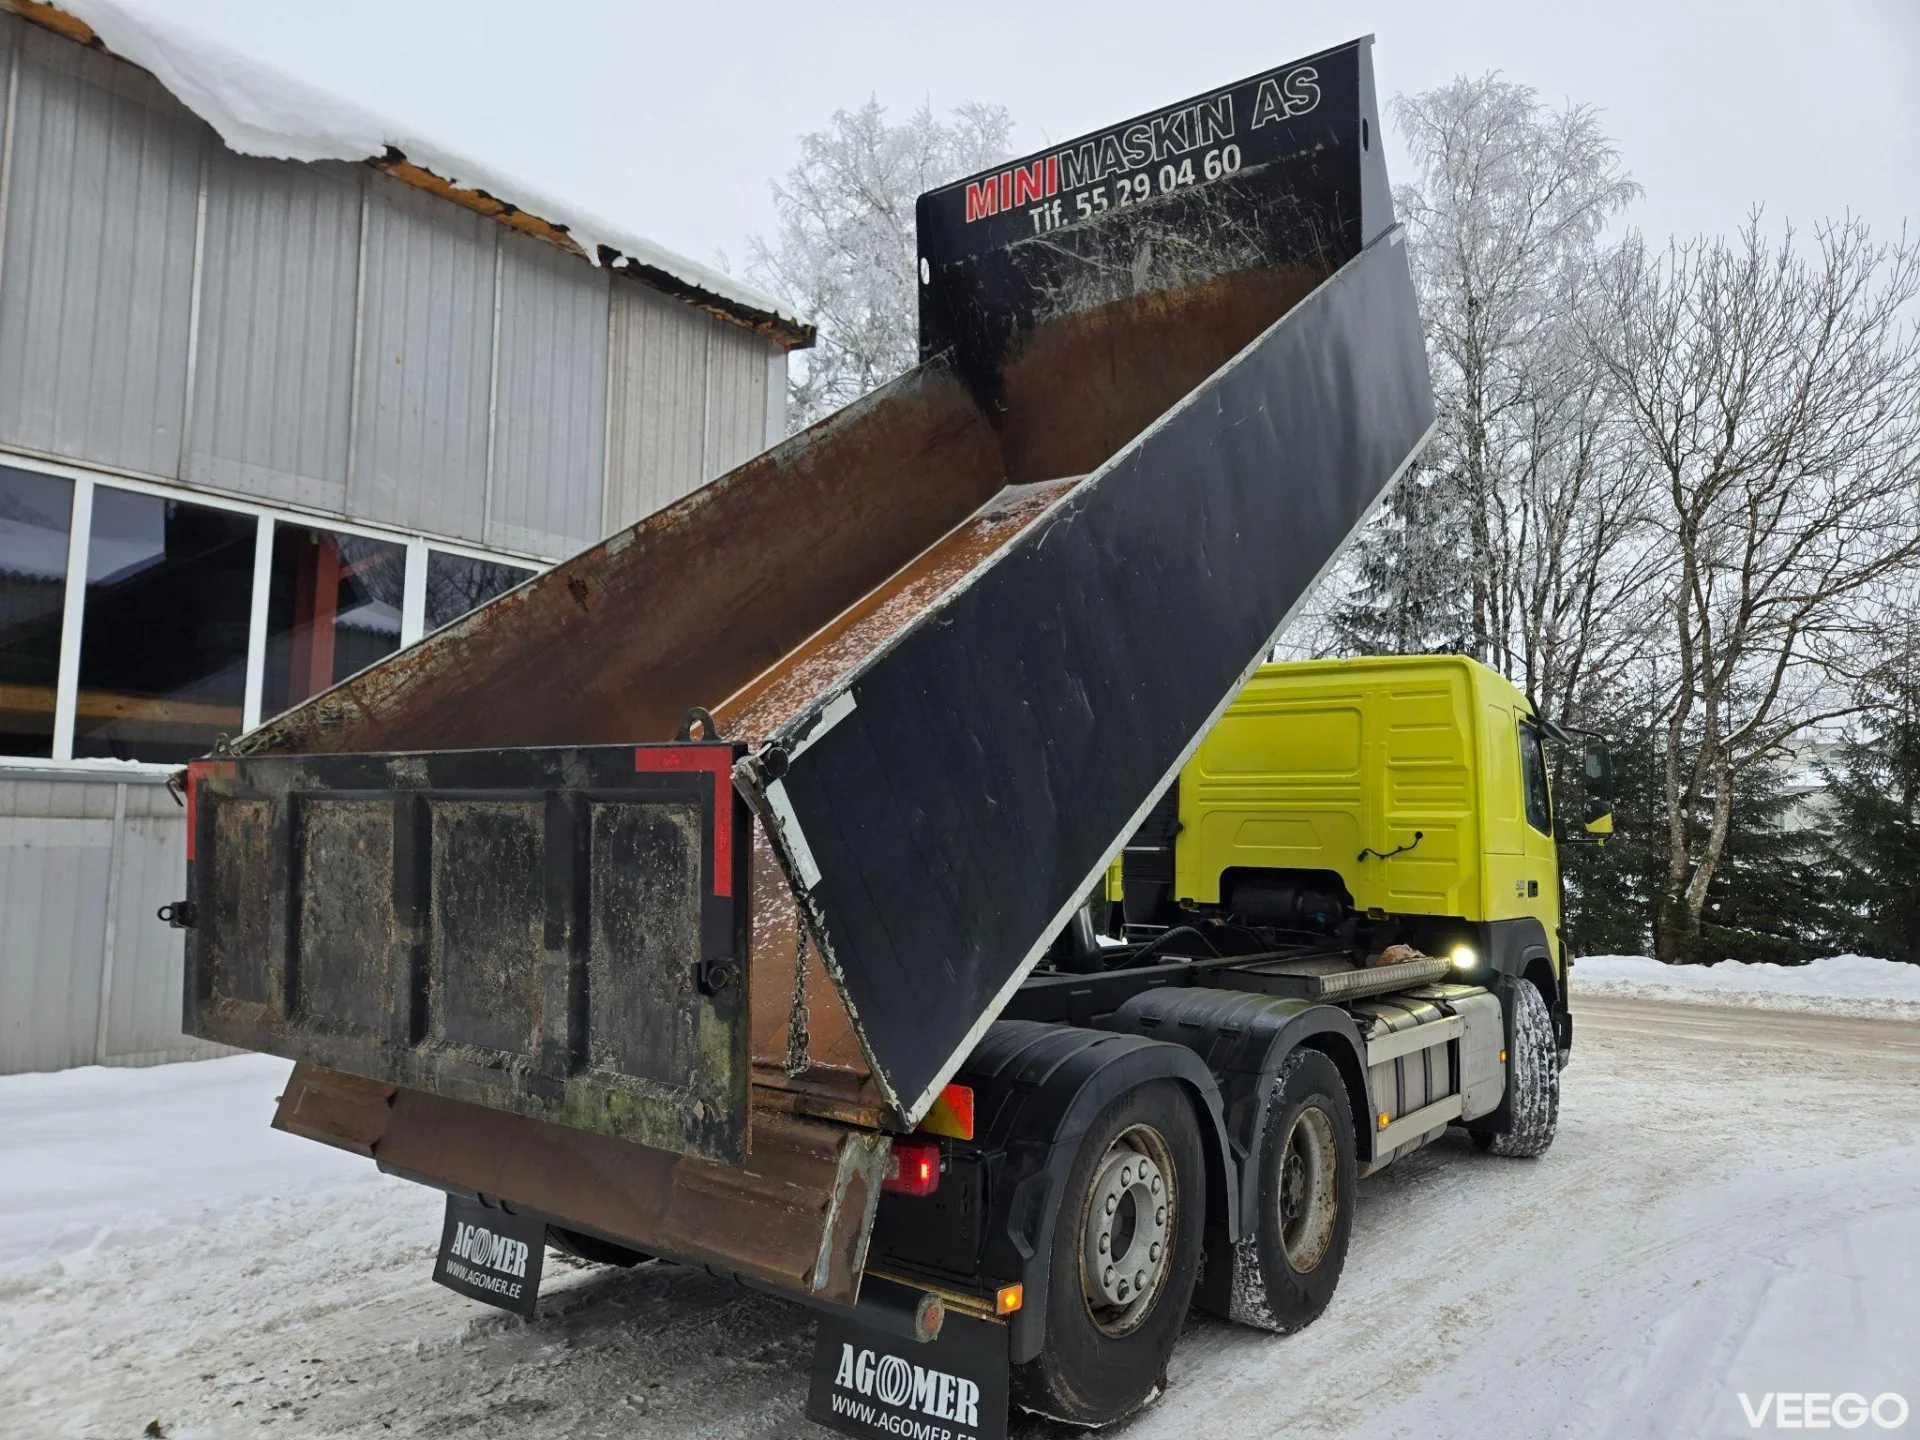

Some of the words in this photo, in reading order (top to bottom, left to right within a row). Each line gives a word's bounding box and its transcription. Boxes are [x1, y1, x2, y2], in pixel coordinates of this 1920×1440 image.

[965, 94, 1236, 223] MINIMASKIN
[1250, 66, 1321, 130] AS
[1076, 186, 1108, 221] 55
[1116, 172, 1151, 208] 29
[1158, 158, 1196, 194] 04
[1204, 144, 1242, 180] 60
[446, 1260, 522, 1299] WWW.AGOMER.EE
[831, 1394, 976, 1440] WWW.AGOMER
